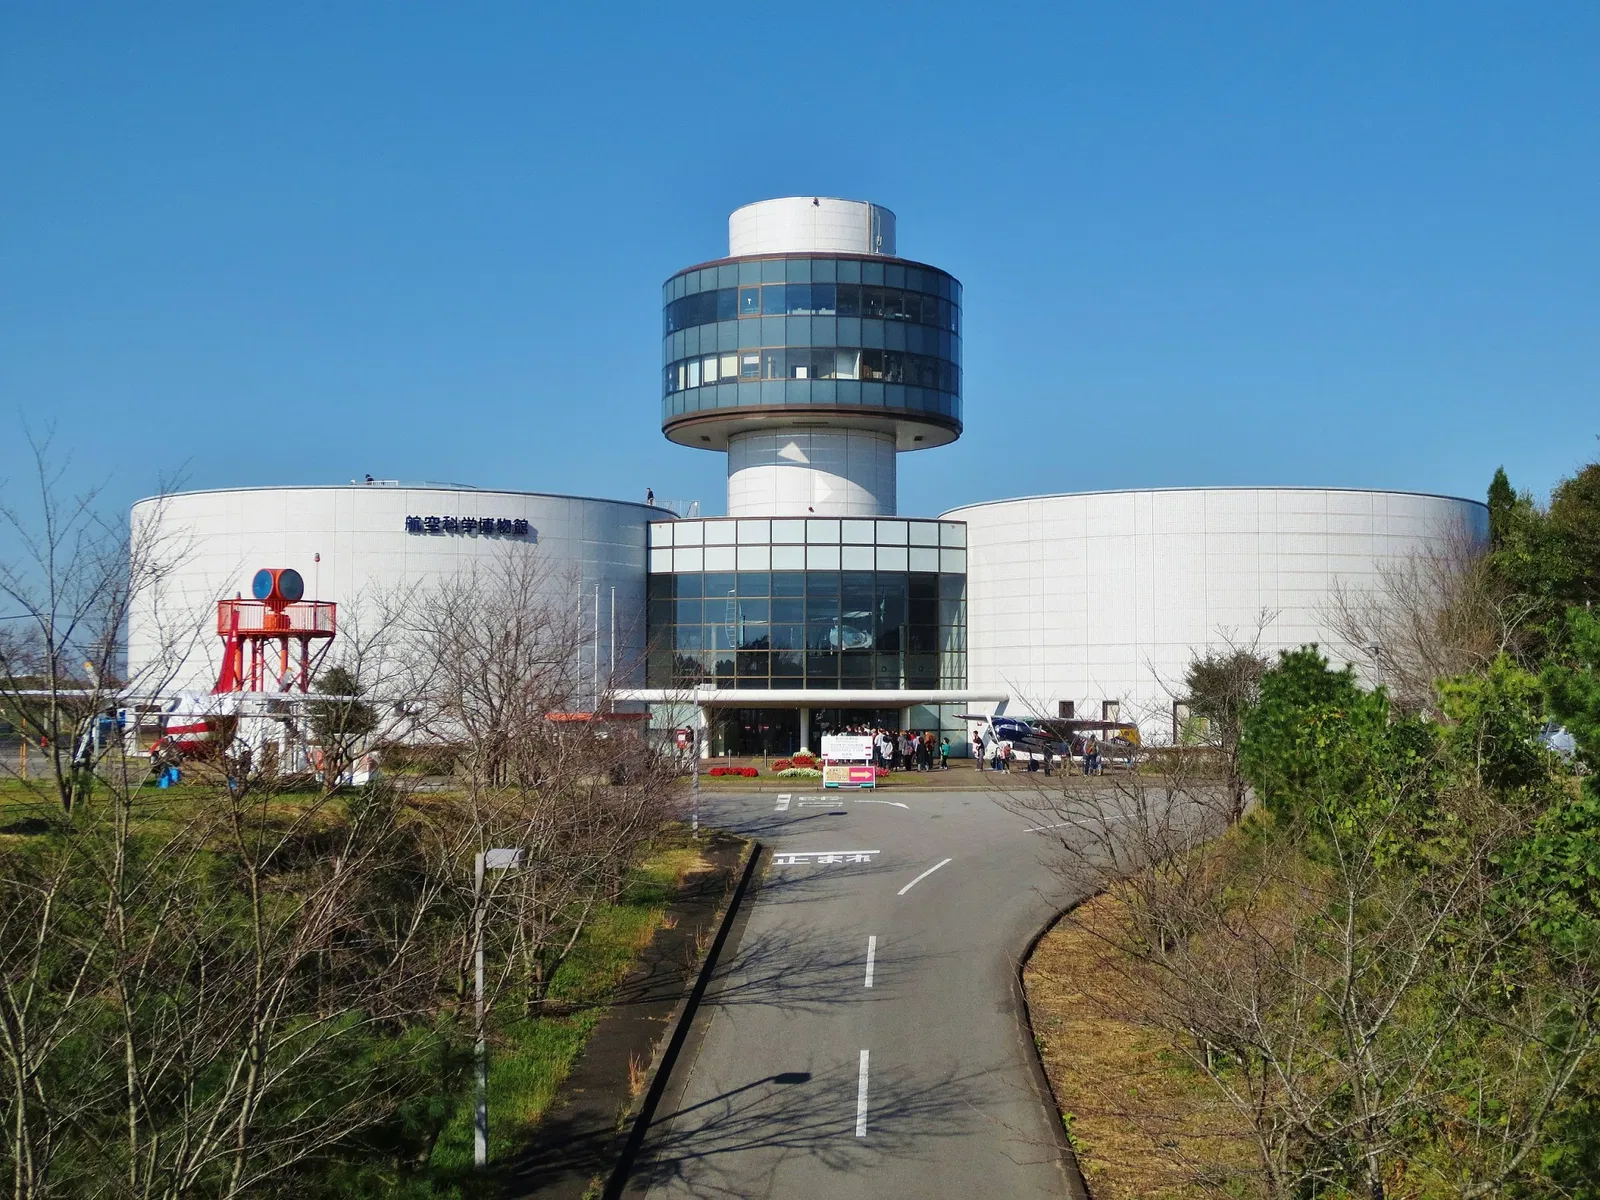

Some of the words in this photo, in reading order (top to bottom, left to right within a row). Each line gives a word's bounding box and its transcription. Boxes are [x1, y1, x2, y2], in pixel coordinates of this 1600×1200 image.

[405, 515, 528, 535] 航空科学博物館
[772, 854, 871, 865] 止まれ
